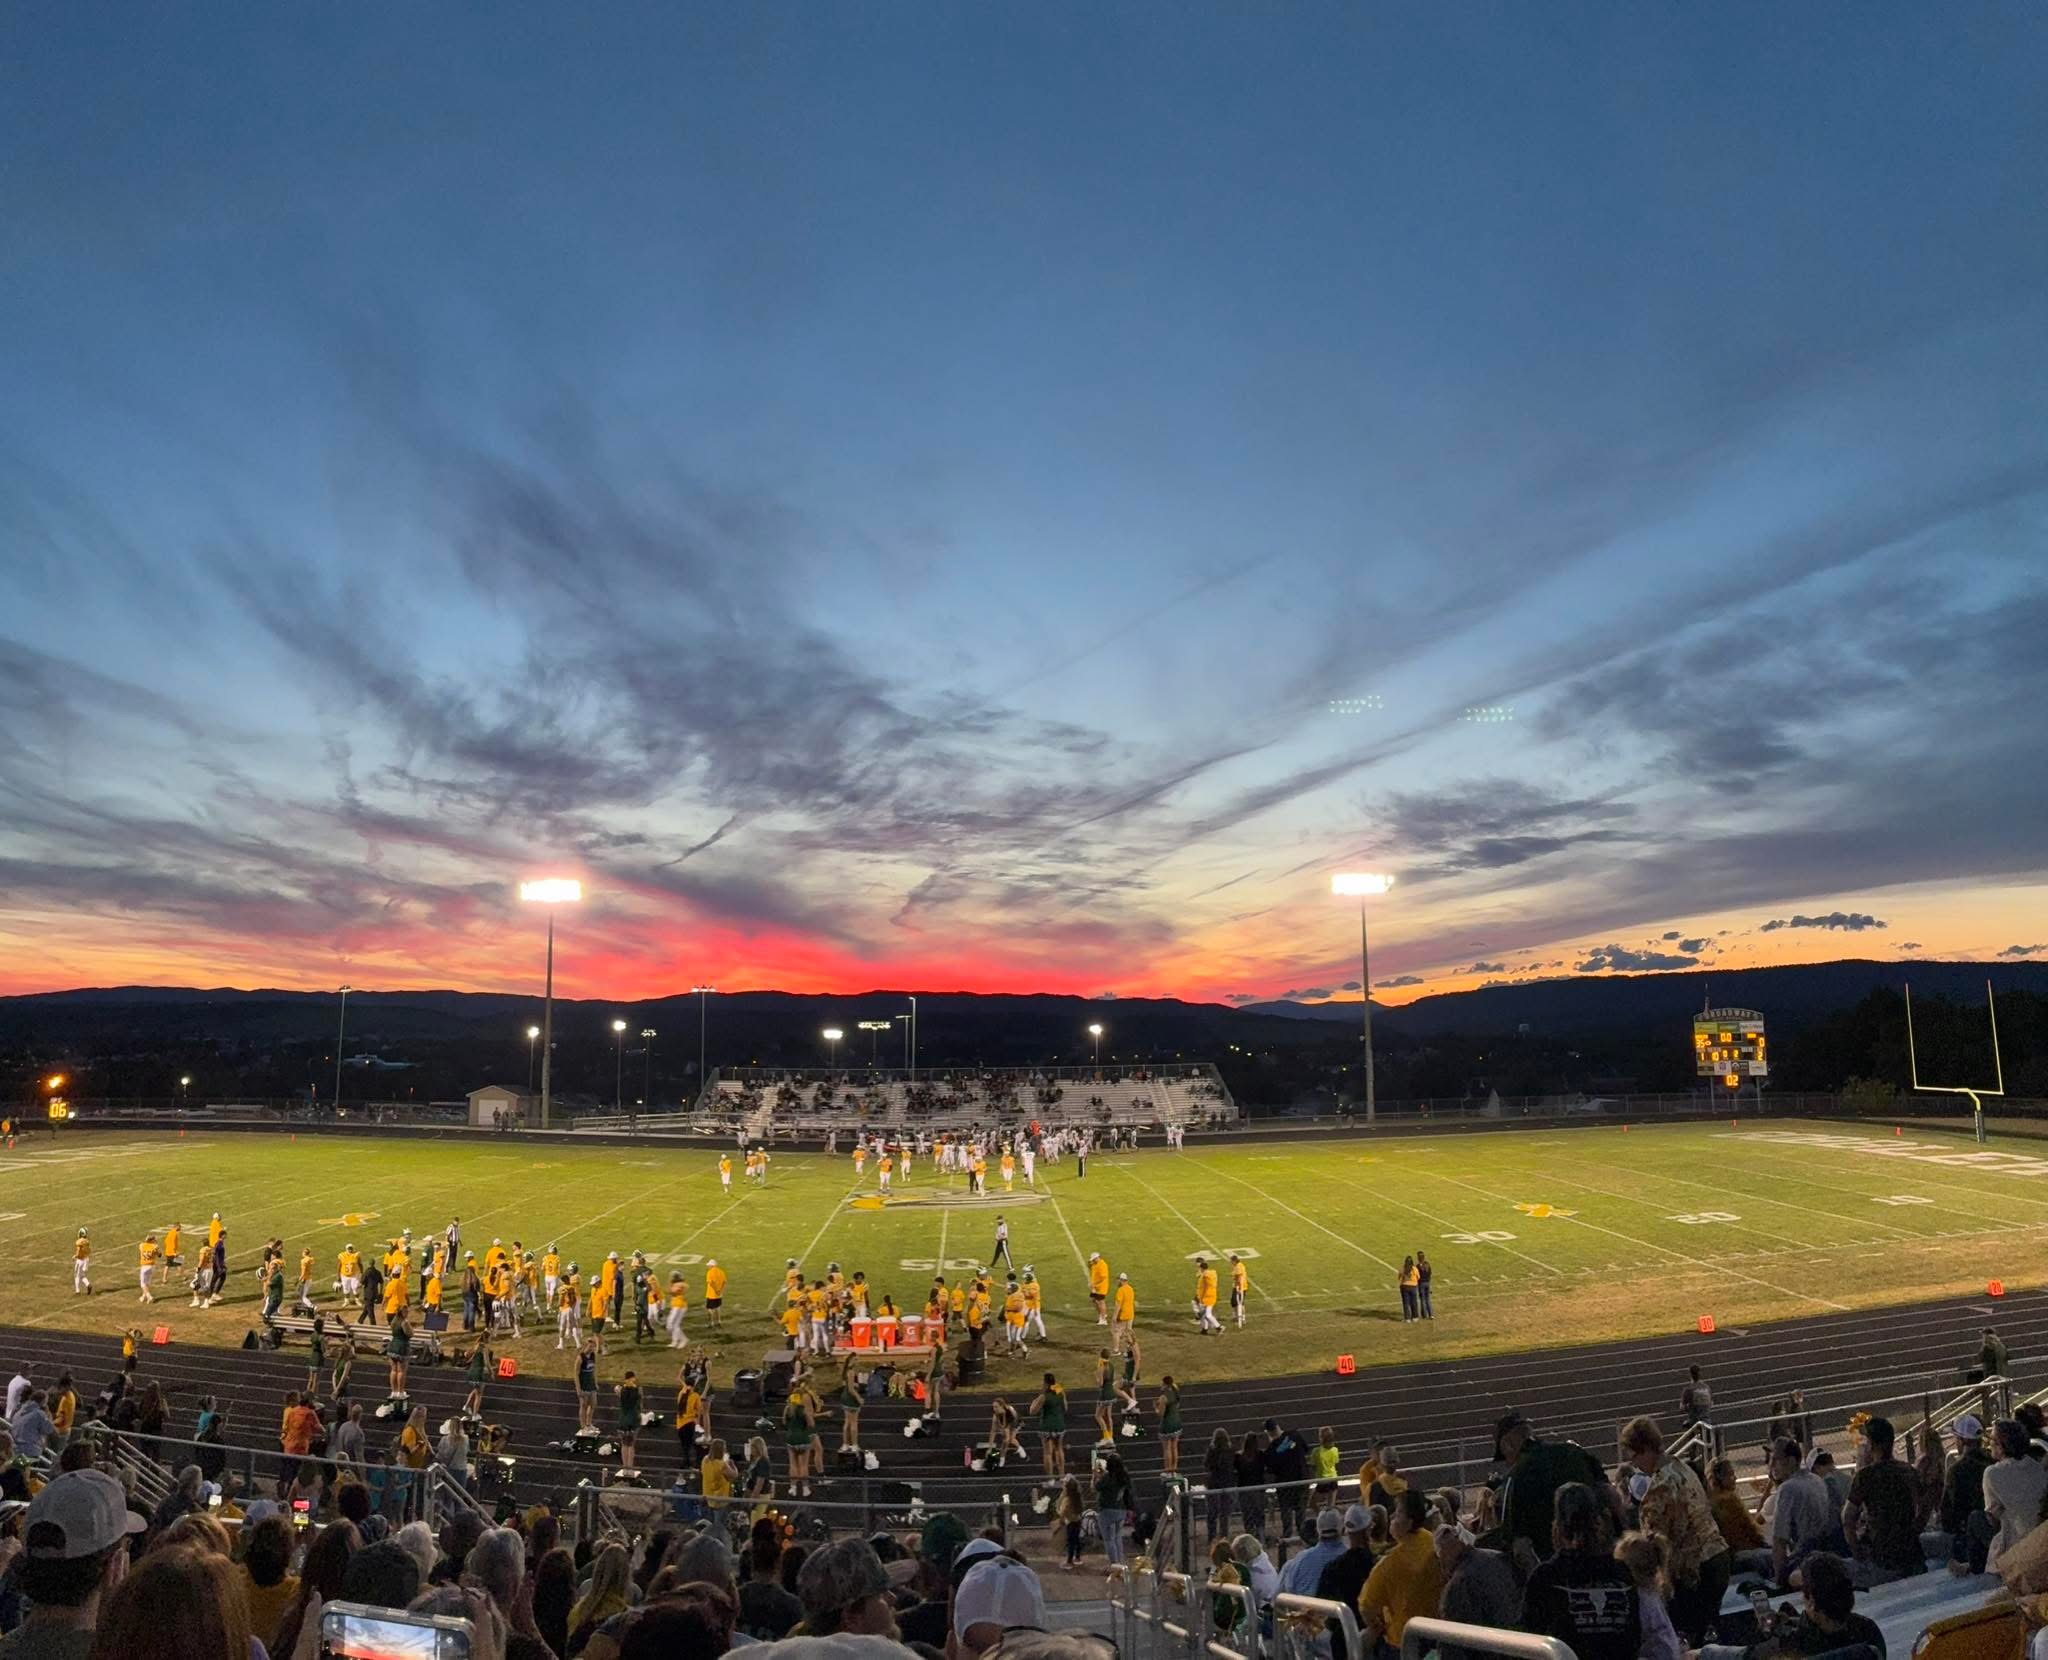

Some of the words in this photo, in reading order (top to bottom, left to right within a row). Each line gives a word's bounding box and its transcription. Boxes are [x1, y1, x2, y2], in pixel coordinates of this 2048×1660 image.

[1726, 1075, 1739, 1086] 02
[50, 1103, 67, 1118] 06
[1665, 1212, 1742, 1224] 20
[1440, 1231, 1519, 1244] 30
[899, 1258, 979, 1271] 50
[1701, 1318, 1713, 1331] 30
[501, 1361, 514, 1375] 40
[1341, 1358, 1353, 1372] 40
